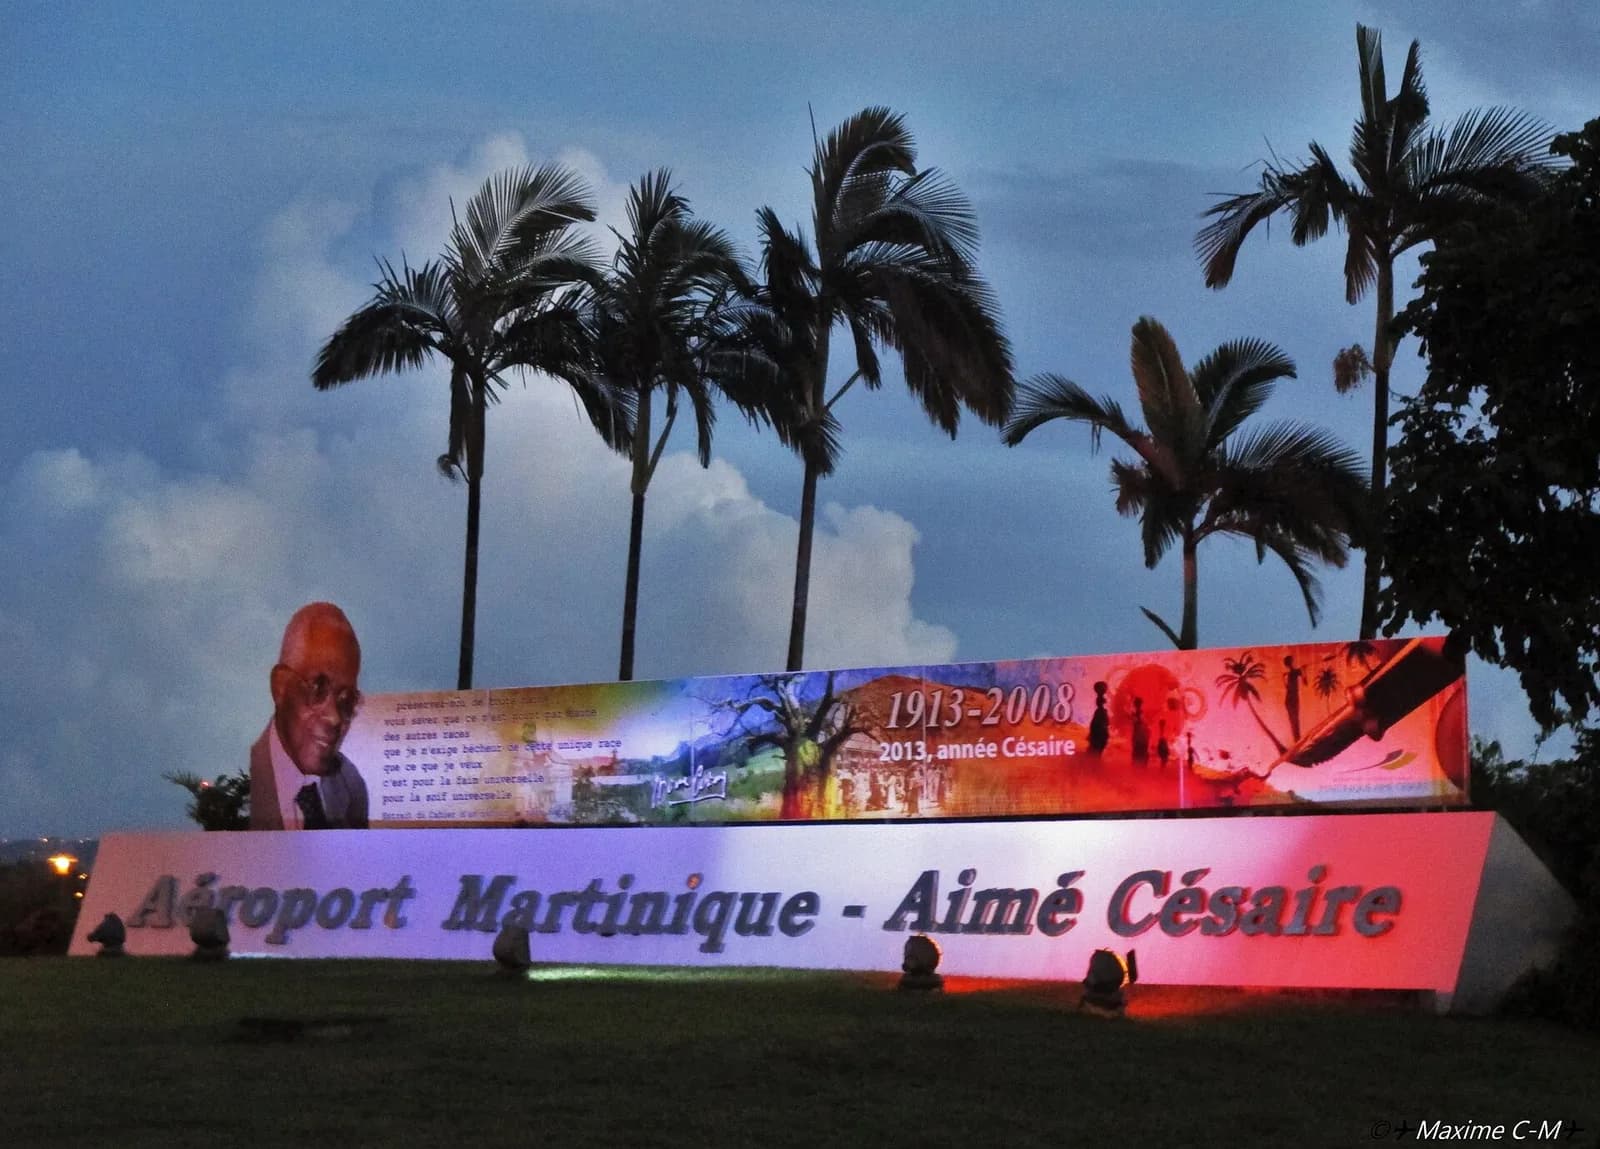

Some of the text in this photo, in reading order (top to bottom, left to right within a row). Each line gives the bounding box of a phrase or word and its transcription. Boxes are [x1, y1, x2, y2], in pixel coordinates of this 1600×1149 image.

[886, 682, 1075, 730] 1913-2008
[384, 717, 405, 726] vous
[443, 716, 460, 726] que
[384, 730, 471, 741] des autres races
[384, 749, 400, 759] que
[406, 746, 417, 758] je
[558, 741, 593, 752] unique
[598, 740, 622, 748] race
[879, 735, 1076, 763] 2013, année Césaire
[384, 761, 483, 774] que ce que je veux
[383, 778, 408, 787] c'est
[412, 778, 435, 789] pour
[439, 775, 451, 786] la
[484, 774, 545, 784] universelle
[382, 789, 512, 806] pour la soif universelle
[130, 866, 1402, 953] Aéroport Martinique - Aimé Césaire
